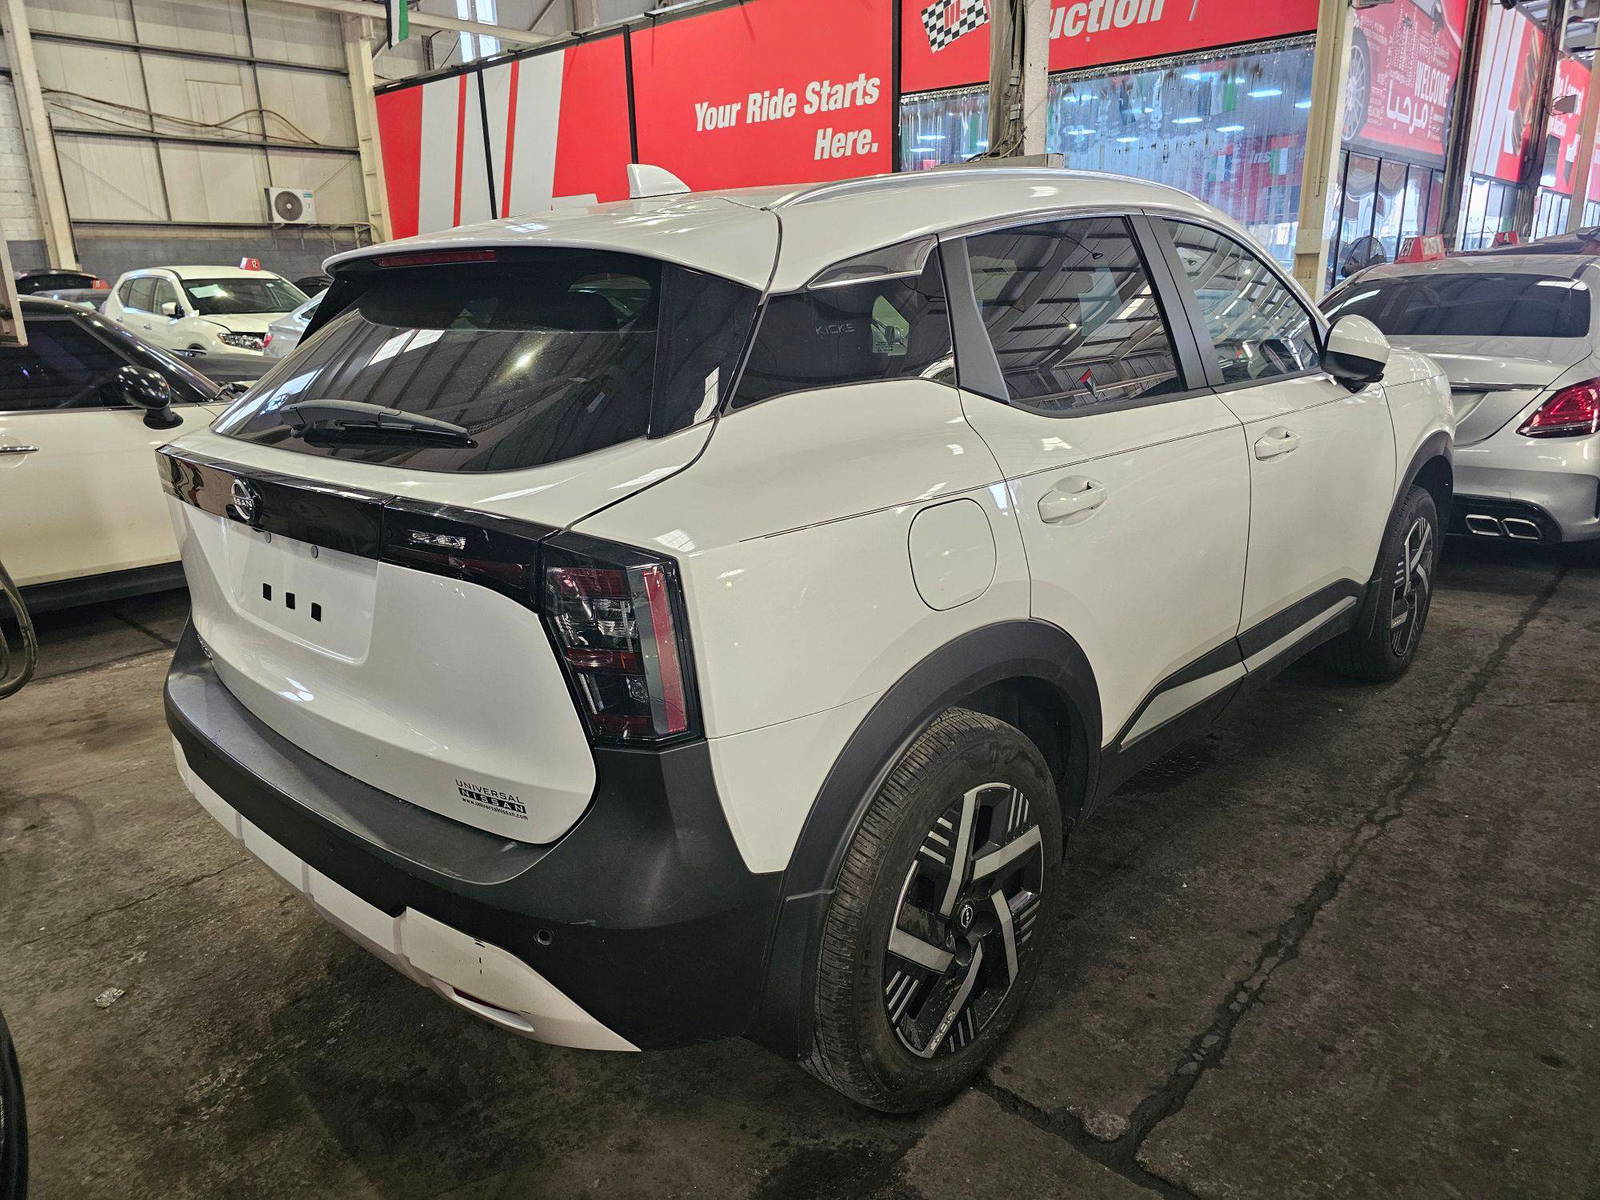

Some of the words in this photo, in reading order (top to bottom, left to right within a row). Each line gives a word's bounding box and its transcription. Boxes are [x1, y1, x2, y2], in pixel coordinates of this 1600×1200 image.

[1049, 0, 1165, 40] uction
[694, 101, 742, 132] Your
[746, 87, 798, 124] Ride
[803, 73, 881, 115] Starts
[1414, 61, 1450, 109] WELCOME
[1386, 79, 1429, 135] مرحبا
[814, 127, 880, 161] Here.
[455, 779, 525, 805] UNIVERSAL
[460, 788, 526, 814] NISSAN
